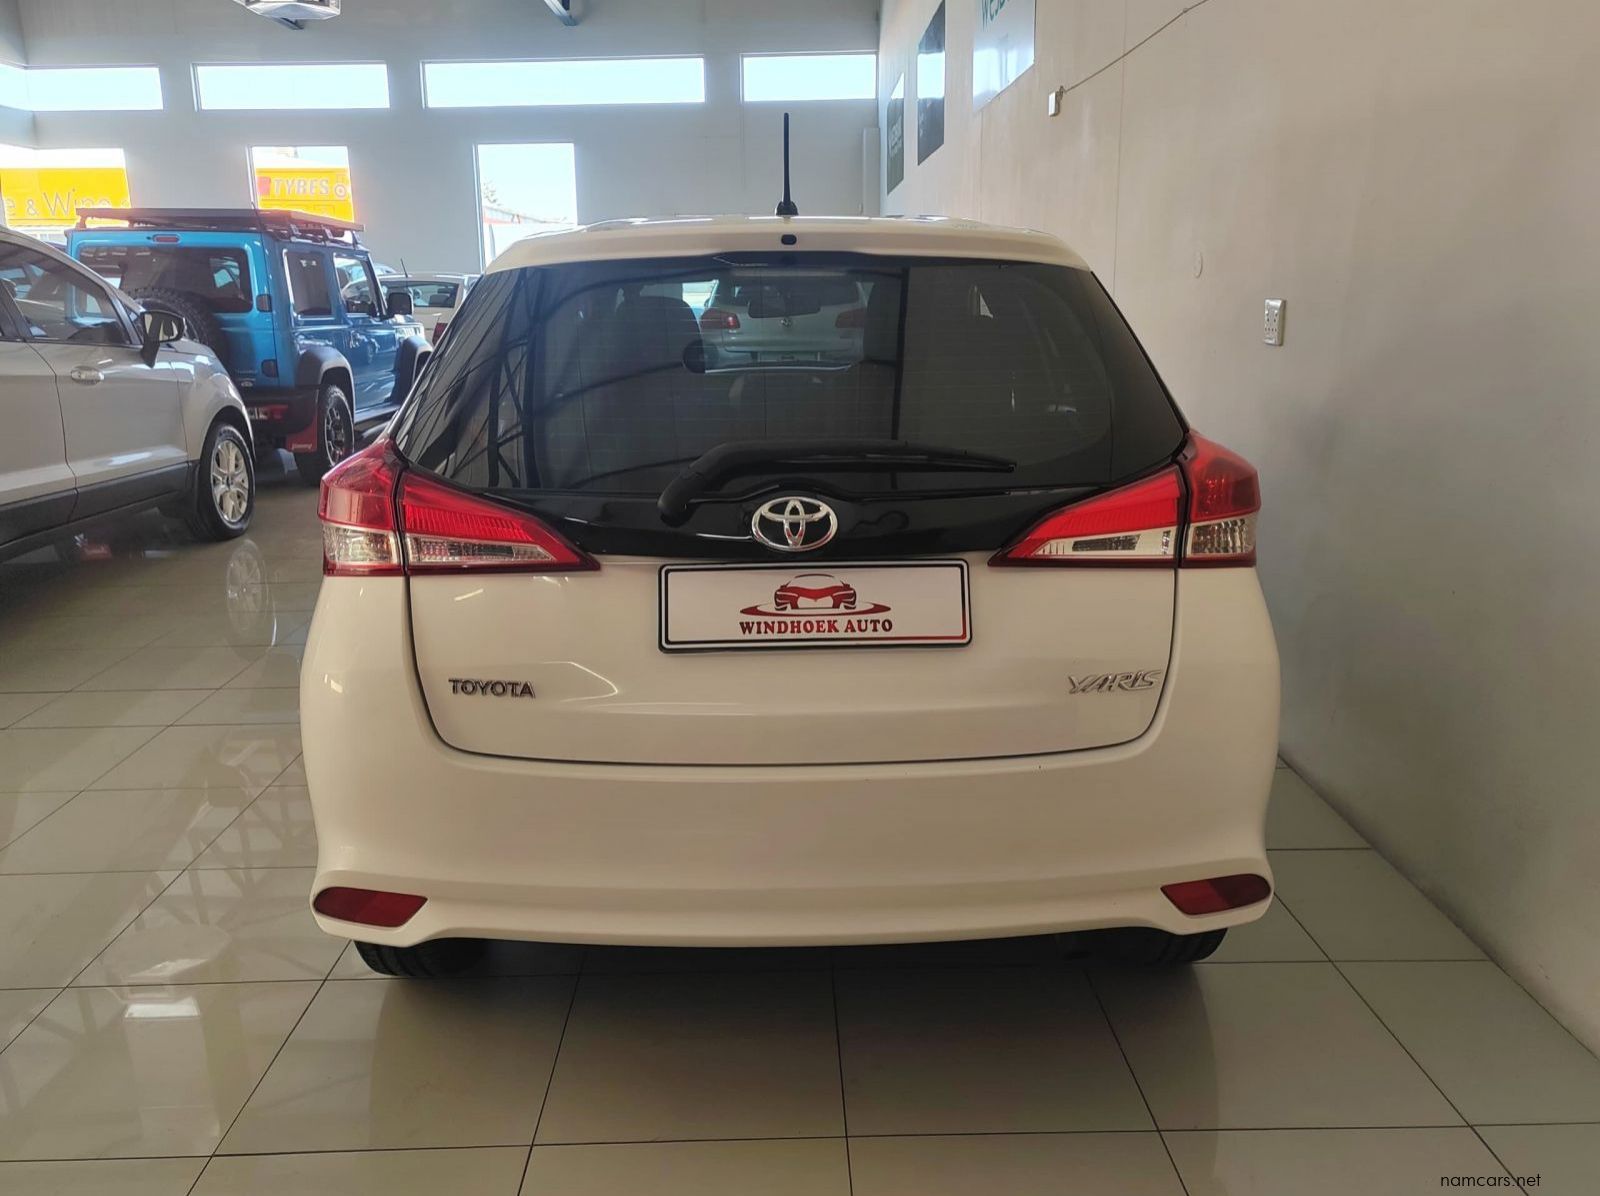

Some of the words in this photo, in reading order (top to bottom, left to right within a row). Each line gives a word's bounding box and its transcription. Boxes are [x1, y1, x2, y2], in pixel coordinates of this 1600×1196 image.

[273, 178, 329, 195] TYRES
[739, 620, 840, 635] WINDHOEK
[844, 618, 893, 633] AUTO
[448, 678, 536, 699] TOYOTA
[1067, 670, 1161, 695] YARIS
